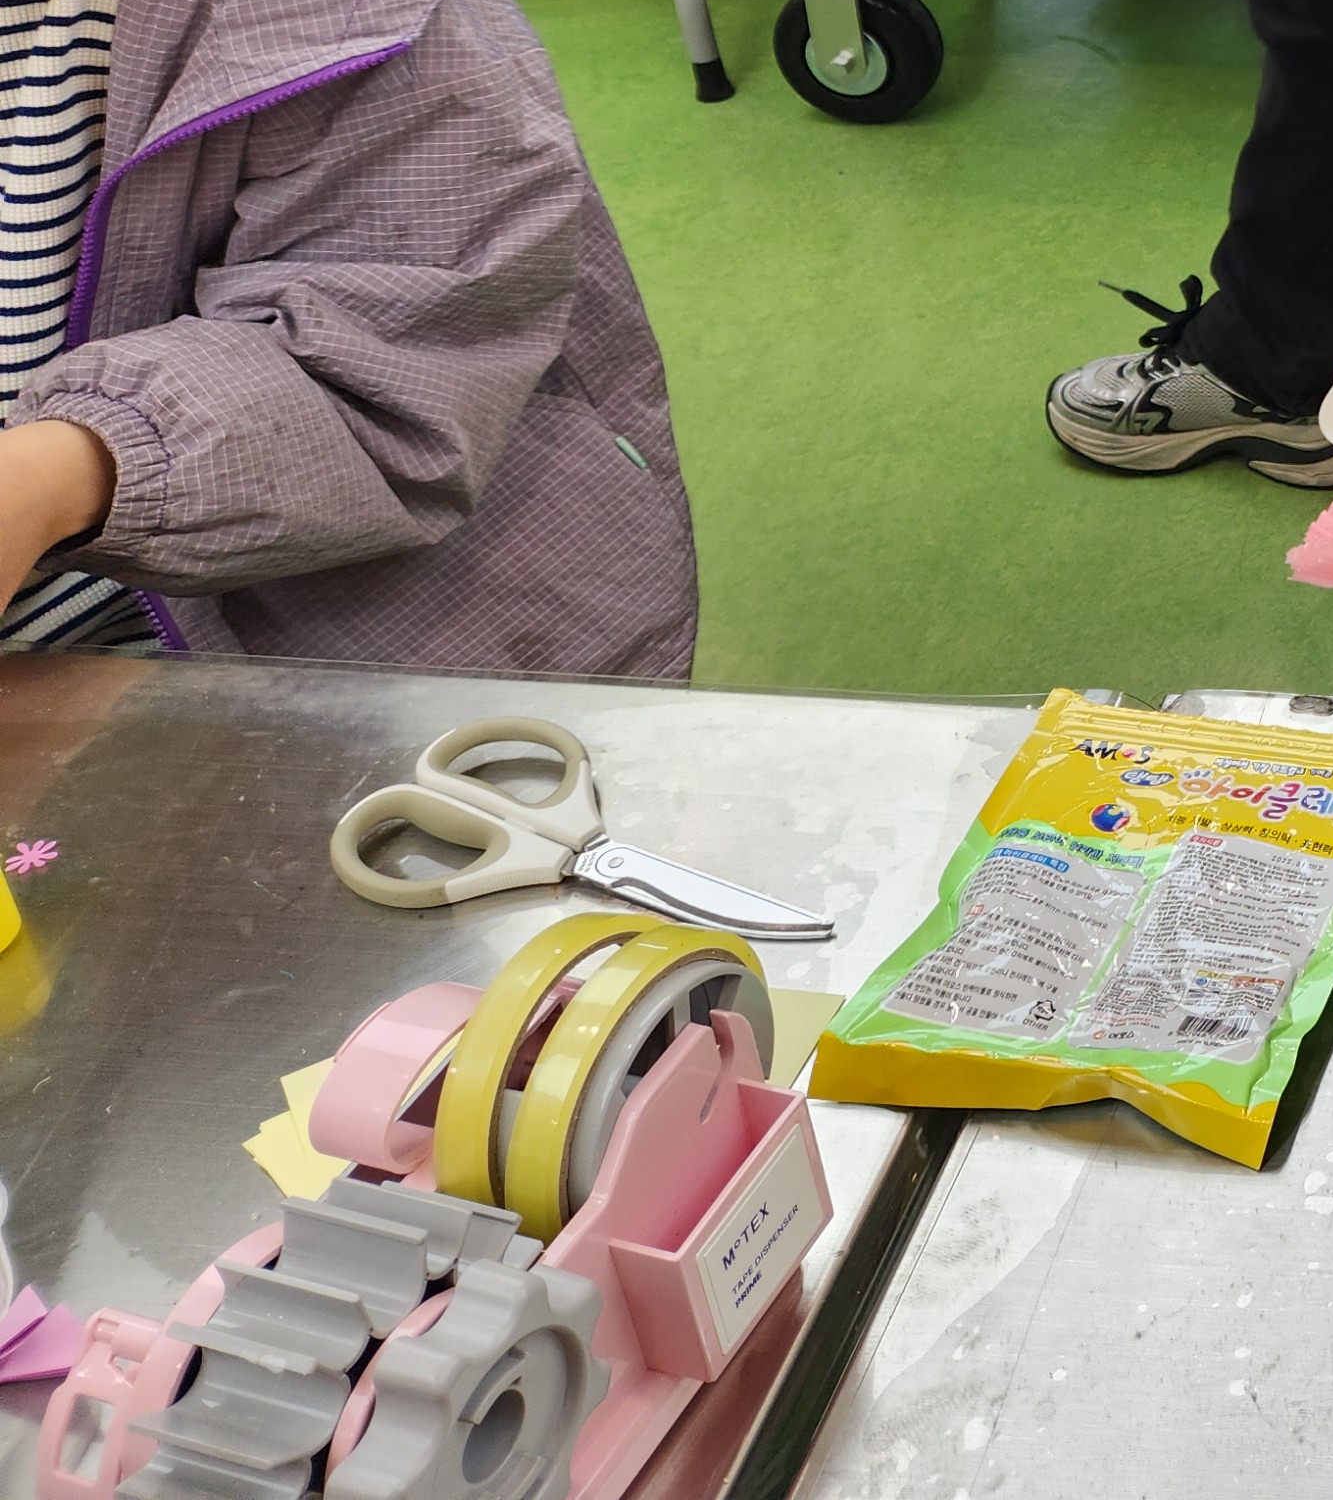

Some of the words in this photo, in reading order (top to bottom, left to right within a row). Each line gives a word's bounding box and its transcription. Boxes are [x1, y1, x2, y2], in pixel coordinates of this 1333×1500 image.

[1251, 760, 1269, 775] 가장
[1022, 1017, 1049, 1032] OTHER
[1108, 1030, 1134, 1040] 아모스
[732, 1265, 754, 1295] TAPE
[754, 1204, 798, 1267] DISPENSER
[735, 1270, 762, 1309] PRIME
